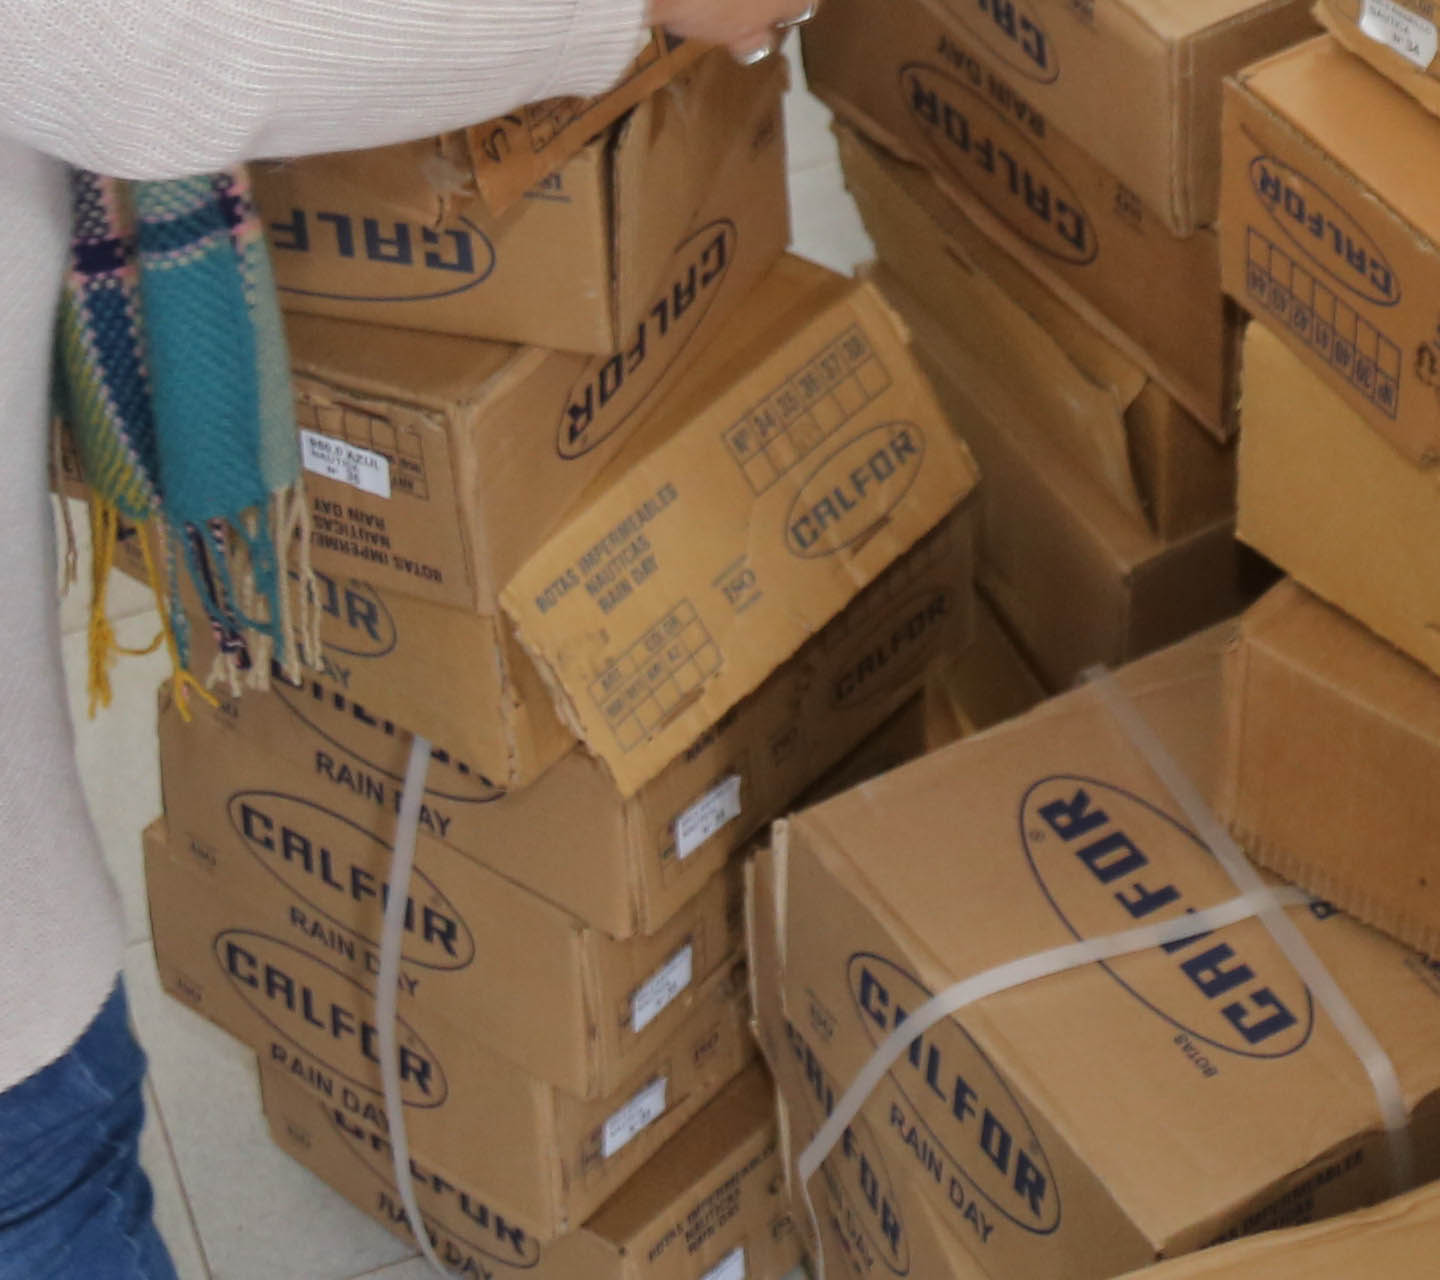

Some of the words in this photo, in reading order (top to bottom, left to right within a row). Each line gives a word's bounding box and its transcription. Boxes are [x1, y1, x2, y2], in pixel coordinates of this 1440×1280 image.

[911, 78, 1086, 250] CALFOR
[1260, 167, 1393, 296] CALFOR
[568, 230, 726, 444] CALFOR
[790, 429, 919, 549] CALFOR
[315, 750, 384, 805] RAIN
[289, 905, 358, 963] RAIN
[271, 1042, 333, 1098] RAIN
[888, 1104, 945, 1184] RAIN
[948, 1175, 992, 1244] DAY
